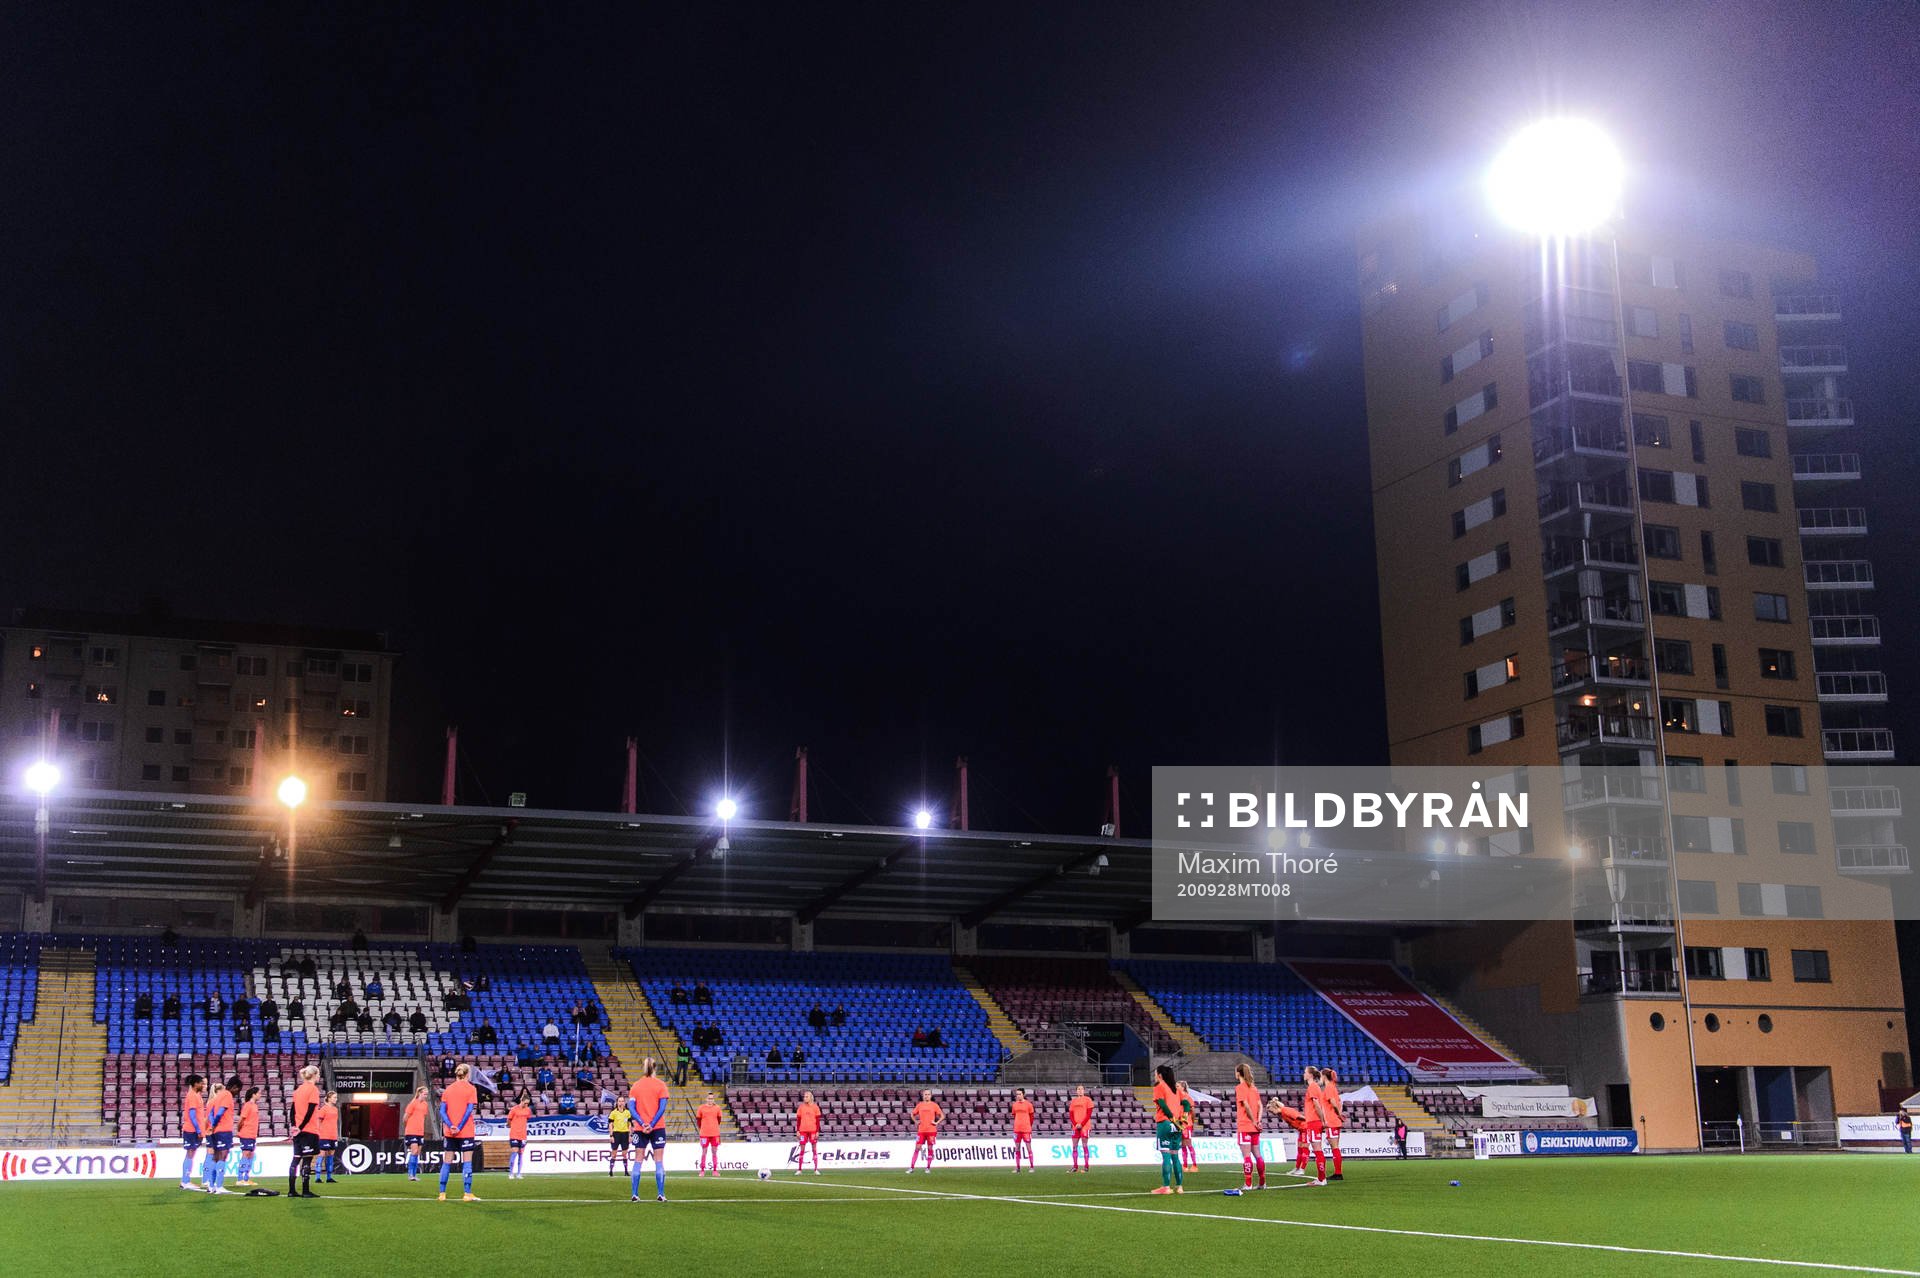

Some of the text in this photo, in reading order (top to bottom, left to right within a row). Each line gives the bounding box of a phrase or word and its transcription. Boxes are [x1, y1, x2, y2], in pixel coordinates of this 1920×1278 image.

[1342, 998, 1432, 1007] ESKILSTUNA
[1353, 1008, 1409, 1016] UNITED
[1491, 1101, 1535, 1112] Sparbanken
[526, 1128, 566, 1136] NITED
[1540, 1136, 1594, 1148] ESKILSTUNA
[1595, 1136, 1628, 1147] UNITED
[1364, 1146, 1423, 1154] MaxFASTIGETER
[1490, 1144, 1516, 1153] RONT
[376, 1151, 392, 1165] PJ
[31, 1154, 130, 1175] exma
